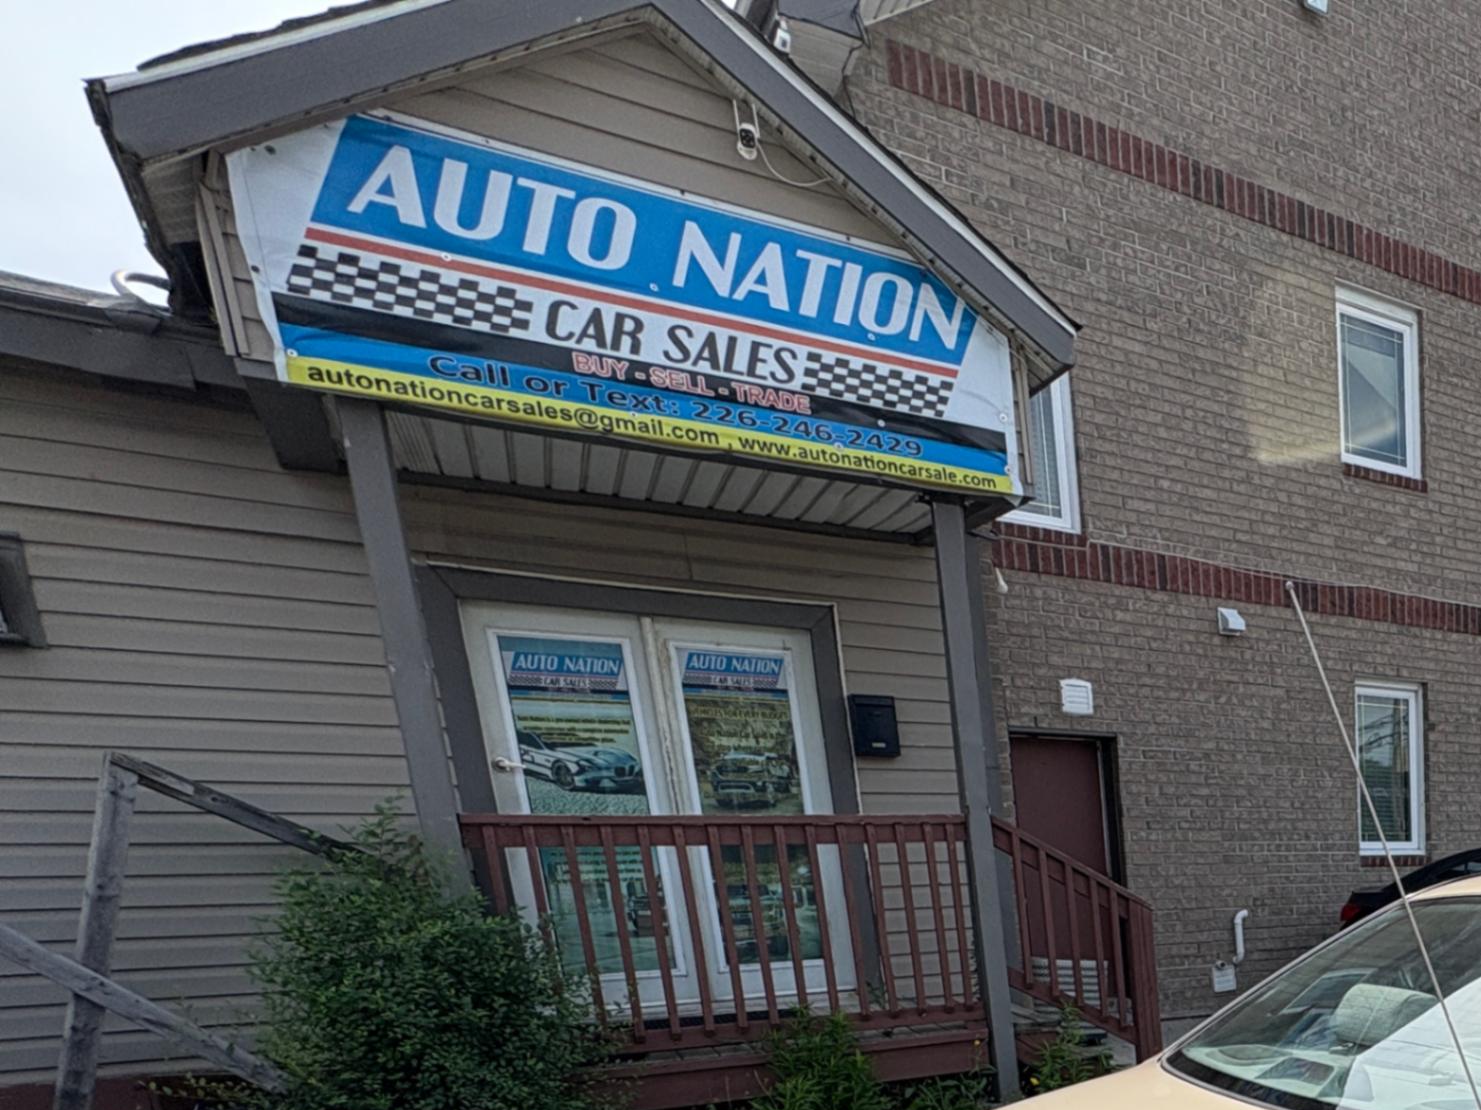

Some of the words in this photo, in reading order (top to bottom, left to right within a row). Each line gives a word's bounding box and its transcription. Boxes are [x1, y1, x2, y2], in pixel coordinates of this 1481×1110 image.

[346, 144, 637, 271] AUTO
[672, 219, 967, 351] NATION
[545, 299, 645, 356] CAR
[662, 324, 799, 385] SALES
[571, 351, 629, 380] BUY
[650, 366, 715, 397] SELL
[730, 382, 813, 415] TRADE
[307, 364, 720, 446] autonationcarsales@gmail.com
[738, 436, 997, 489] www.autonationcarsale.com
[428, 355, 511, 387] Call
[525, 375, 568, 397] or
[579, 380, 681, 416] Text:
[691, 400, 924, 457] 226-246-2429
[514, 652, 559, 671] AUTO
[563, 656, 620, 675] NATION
[688, 653, 727, 671] AUTO
[731, 656, 780, 675] NATION
